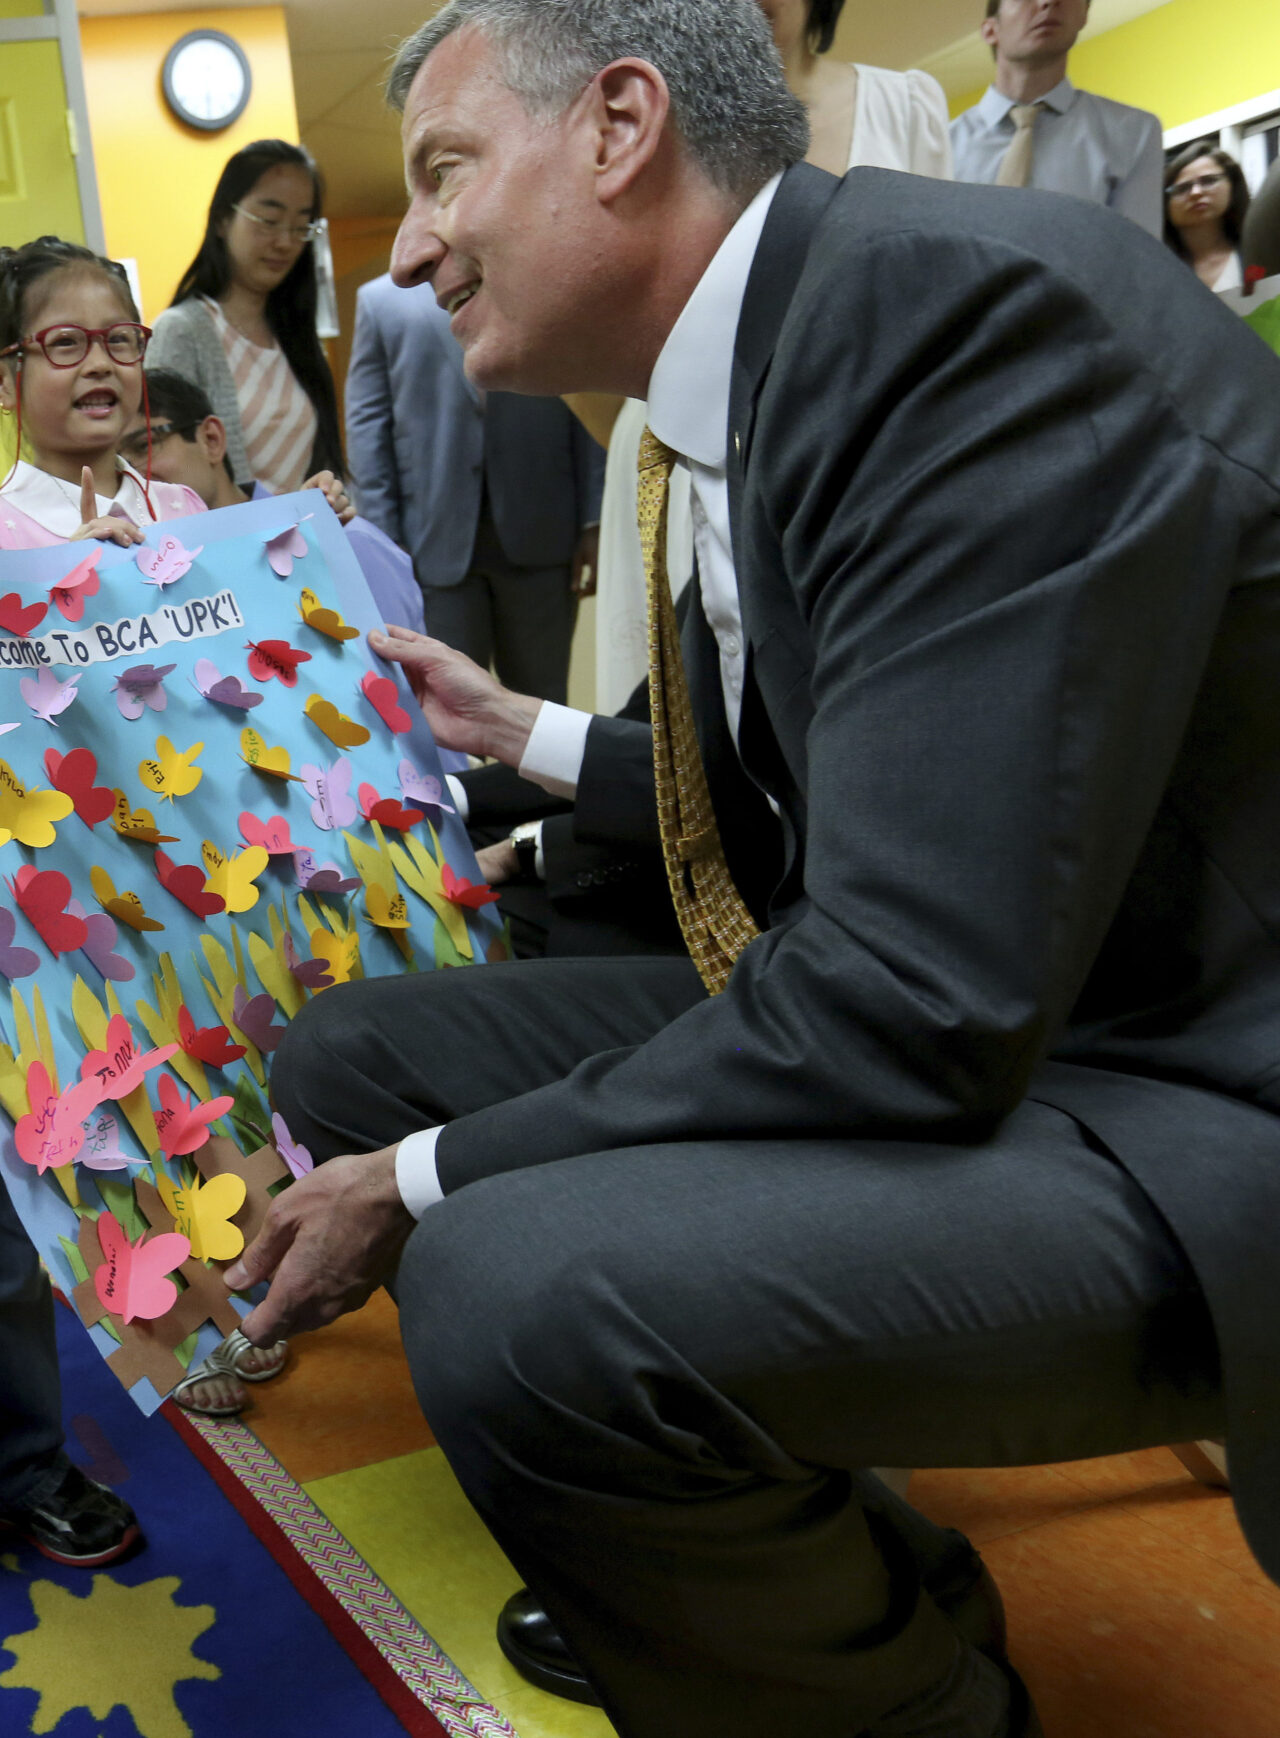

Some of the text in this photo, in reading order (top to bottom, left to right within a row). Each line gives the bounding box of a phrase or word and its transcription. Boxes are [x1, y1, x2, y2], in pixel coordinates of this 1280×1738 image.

[51, 634, 89, 663] To
[95, 616, 158, 657] BCA
[163, 593, 241, 637] 'UPK'!
